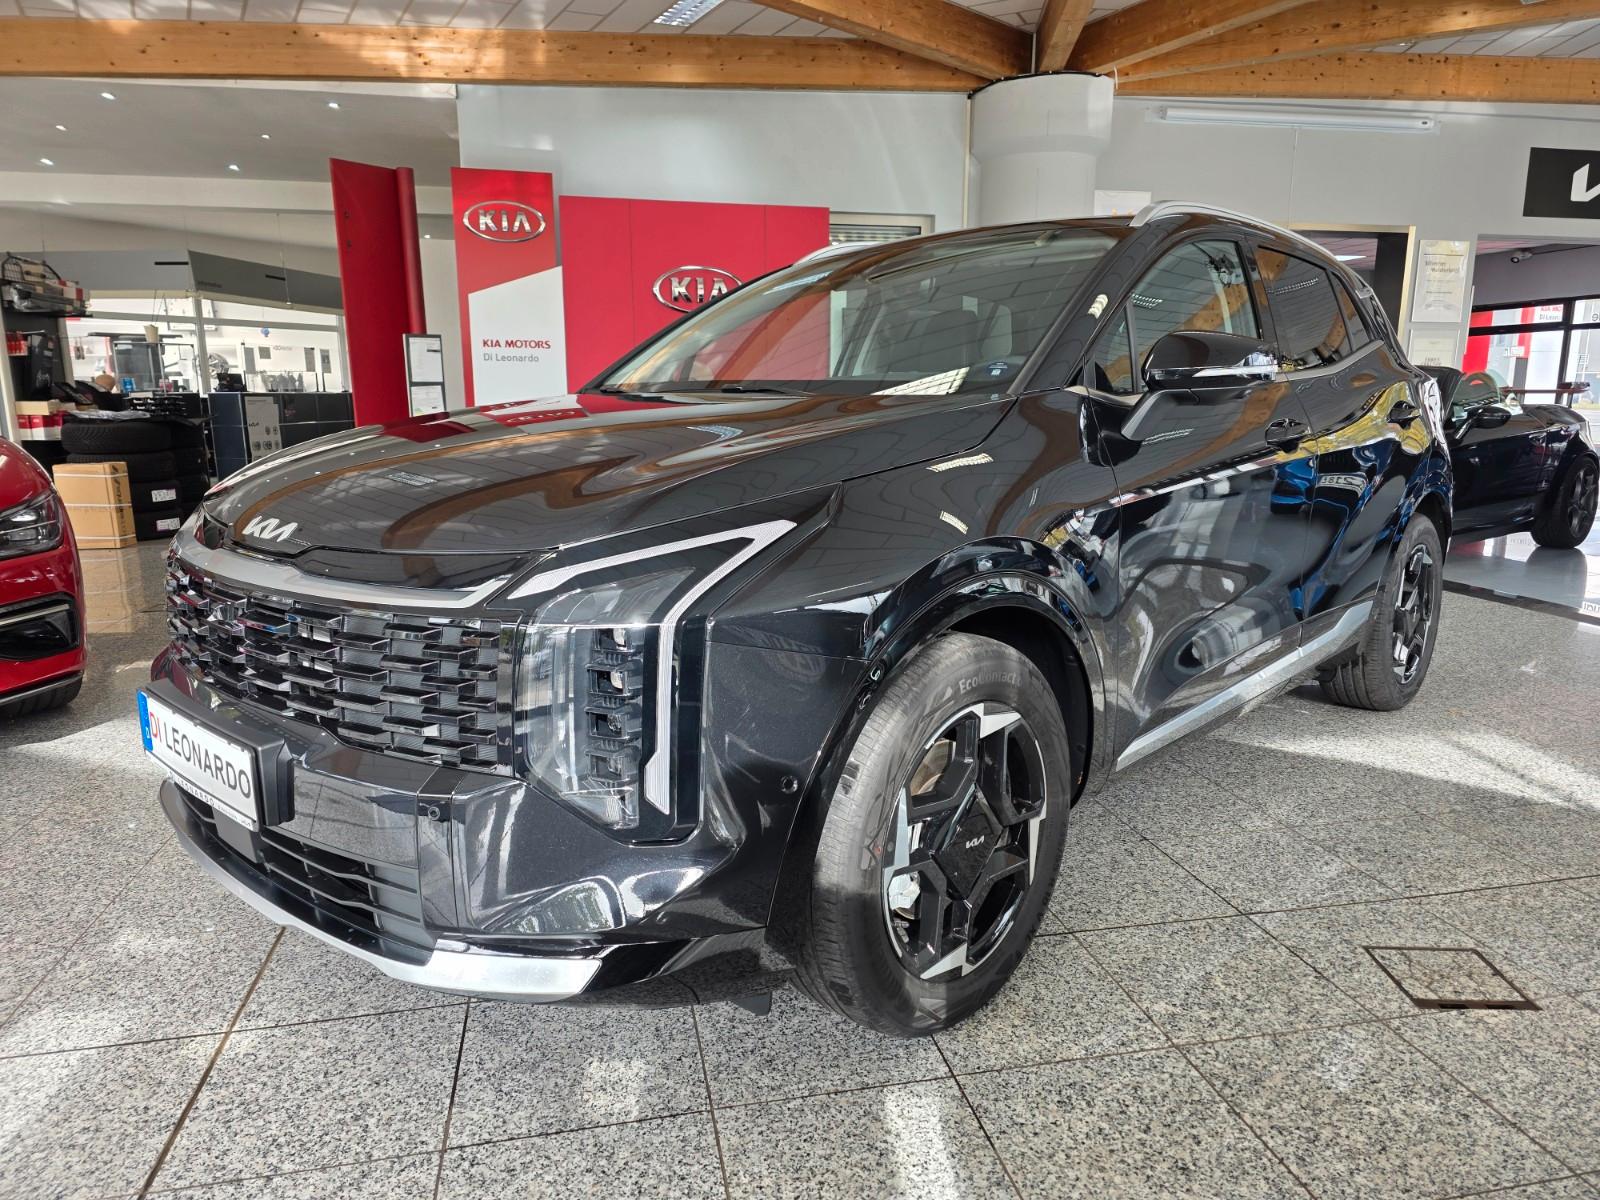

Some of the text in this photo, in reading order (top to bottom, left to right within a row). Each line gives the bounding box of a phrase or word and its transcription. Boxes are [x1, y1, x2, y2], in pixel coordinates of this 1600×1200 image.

[478, 209, 531, 232] KIA
[670, 276, 728, 303] KIA
[482, 339, 551, 349] KIA MOTORS
[483, 353, 540, 362] Di Leonardo
[241, 515, 298, 542] KIA
[149, 711, 251, 799] DI LEONARDO
